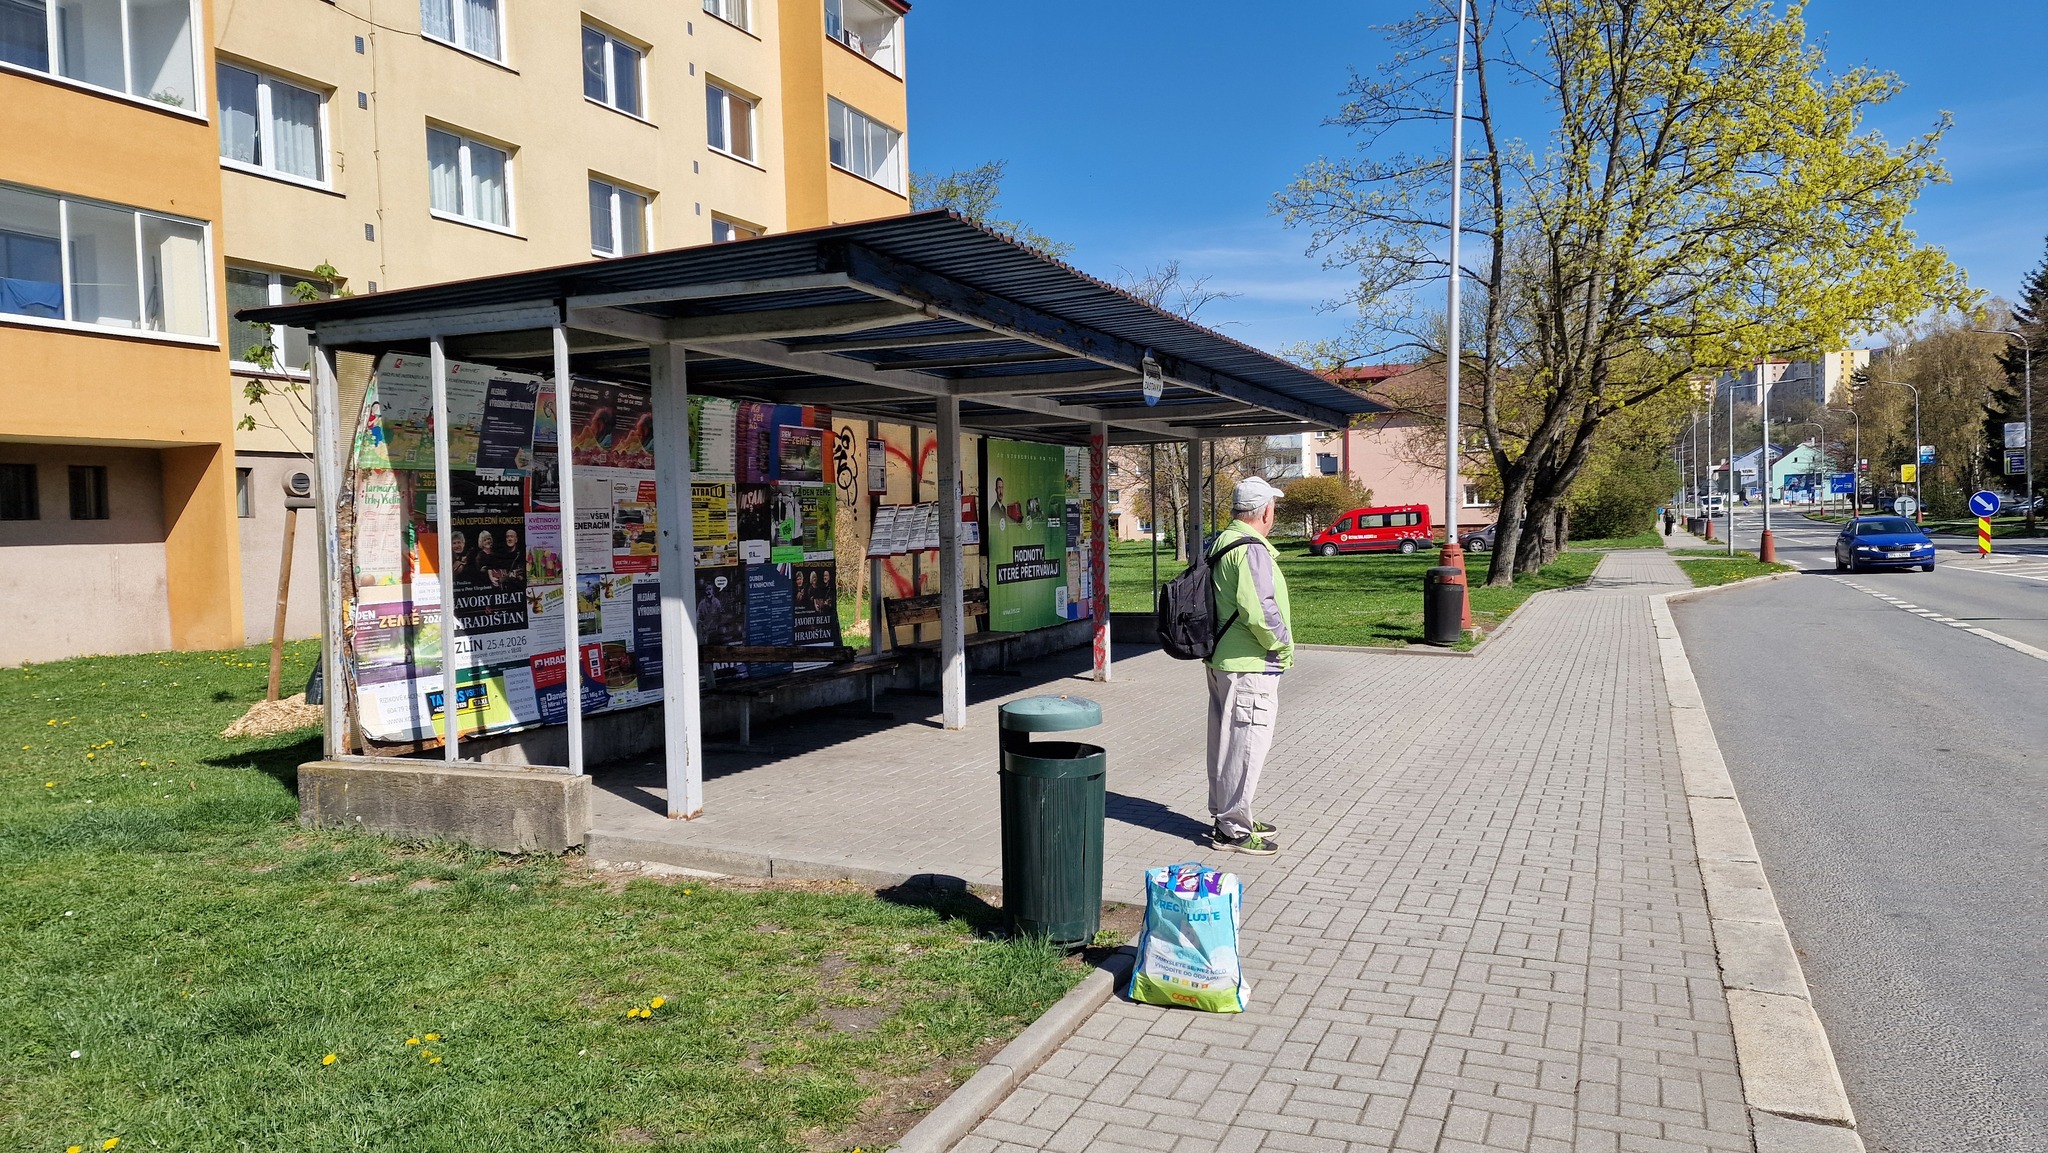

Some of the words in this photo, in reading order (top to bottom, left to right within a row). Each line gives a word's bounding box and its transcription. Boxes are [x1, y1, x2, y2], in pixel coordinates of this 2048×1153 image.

[478, 483, 519, 496] PLOŠTINA
[452, 516, 464, 526] DÁN
[498, 515, 524, 526] KONCERT
[590, 511, 610, 520] VŠEM
[575, 520, 610, 530] ENERACÍM
[1014, 548, 1044, 562] HODNOTY,
[998, 564, 1020, 582] KTERÉ
[1020, 560, 1059, 579] PŘETRVÁVAJÍ
[454, 594, 493, 609] AVORY
[495, 592, 523, 605] BEAT
[378, 609, 420, 629] ZEMĚ
[794, 617, 816, 628] JAVORY
[817, 615, 831, 624] BEAT
[794, 629, 831, 641] HRADIŠŤAN
[455, 639, 483, 653] ZLÍN
[487, 636, 527, 650] 25.4.2026
[544, 655, 568, 668] HRAD
[546, 689, 567, 701] Danie
[1154, 962, 1183, 974] VYHODÍTE
[1155, 955, 1186, 968] ZAMYSLETE
[1171, 992, 1198, 1003] coop
